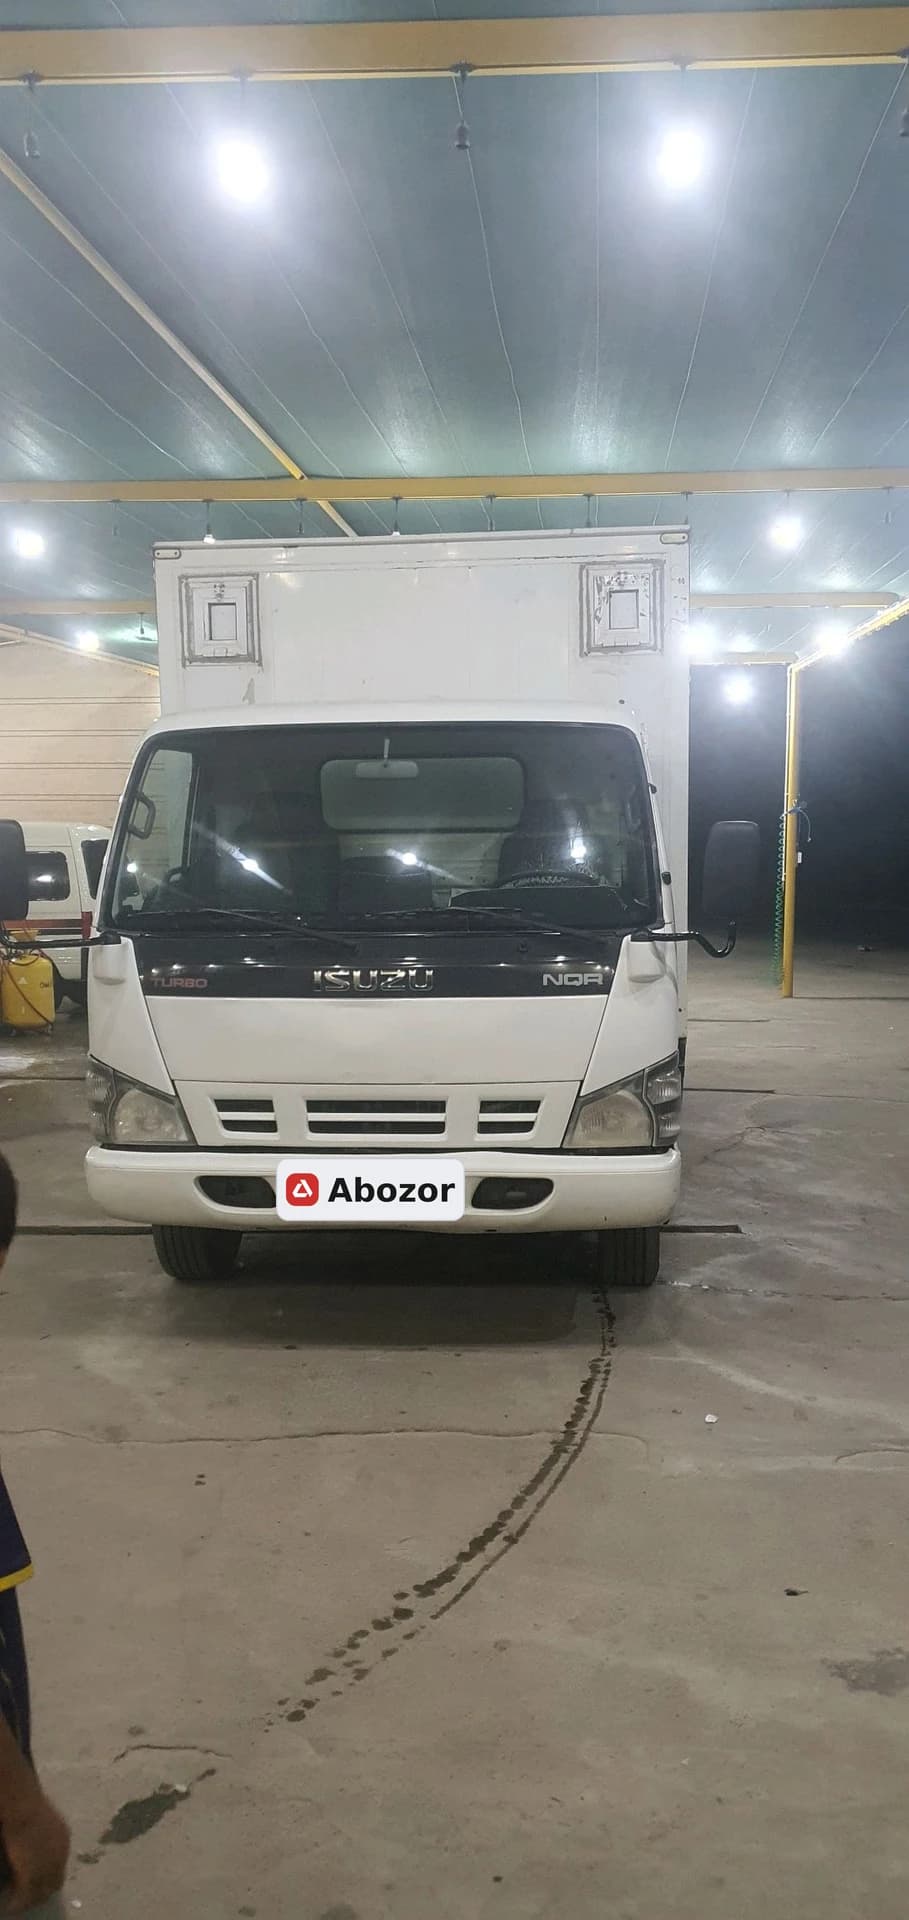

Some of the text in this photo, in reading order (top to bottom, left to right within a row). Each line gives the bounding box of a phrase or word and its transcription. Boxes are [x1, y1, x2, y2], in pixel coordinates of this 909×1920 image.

[150, 977, 208, 988] TURBO
[313, 969, 434, 992] ISUZU
[542, 973, 604, 986] NQR
